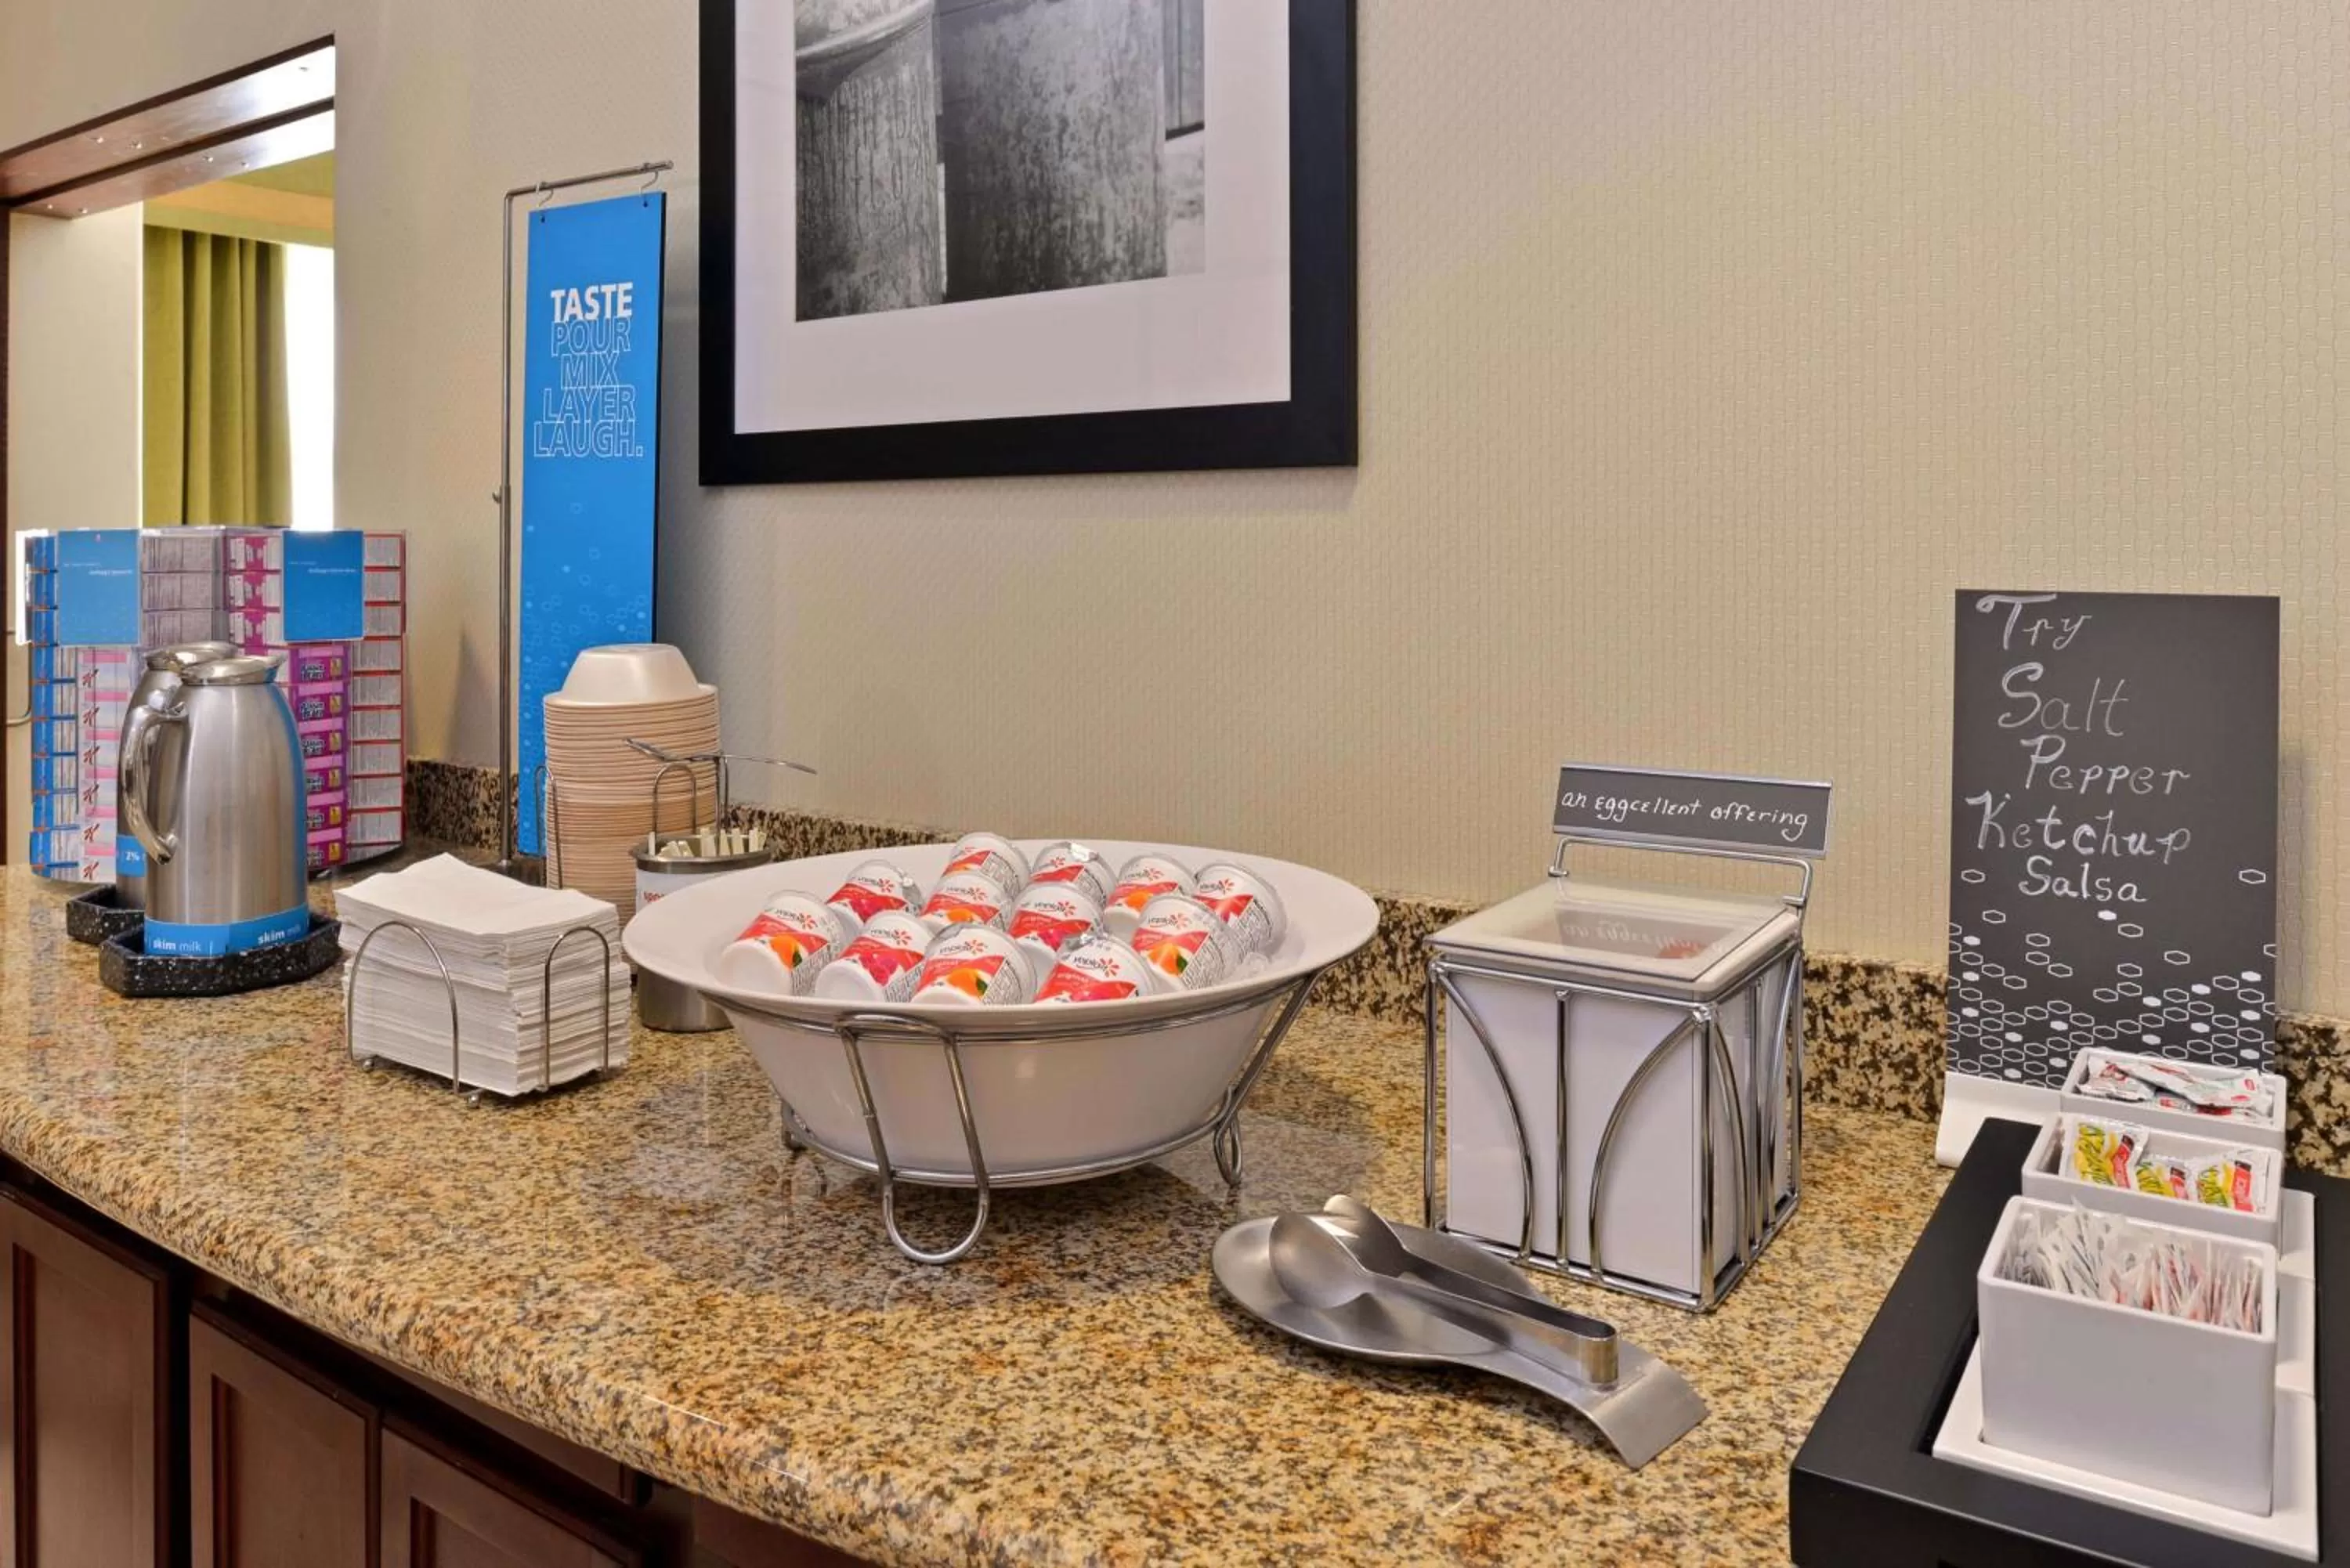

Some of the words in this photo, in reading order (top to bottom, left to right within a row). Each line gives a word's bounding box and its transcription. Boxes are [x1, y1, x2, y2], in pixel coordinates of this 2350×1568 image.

[551, 282, 633, 323] TASTE
[551, 316, 631, 357] POUR
[561, 351, 619, 389] MIX
[543, 385, 636, 423] LAYER
[533, 420, 643, 457] LAUGH.
[1976, 594, 2092, 650] Try
[1998, 662, 2129, 737] Salt
[2020, 734, 2191, 795] Pepper
[1561, 791, 1586, 808] an
[1595, 796, 1701, 822] eggcellent
[1710, 802, 1808, 842] offering
[1965, 789, 2192, 864] Ketchup
[2019, 855, 2147, 902] Salsa
[153, 938, 176, 950] skim
[179, 940, 201, 952] milk
[258, 930, 285, 945] skim
